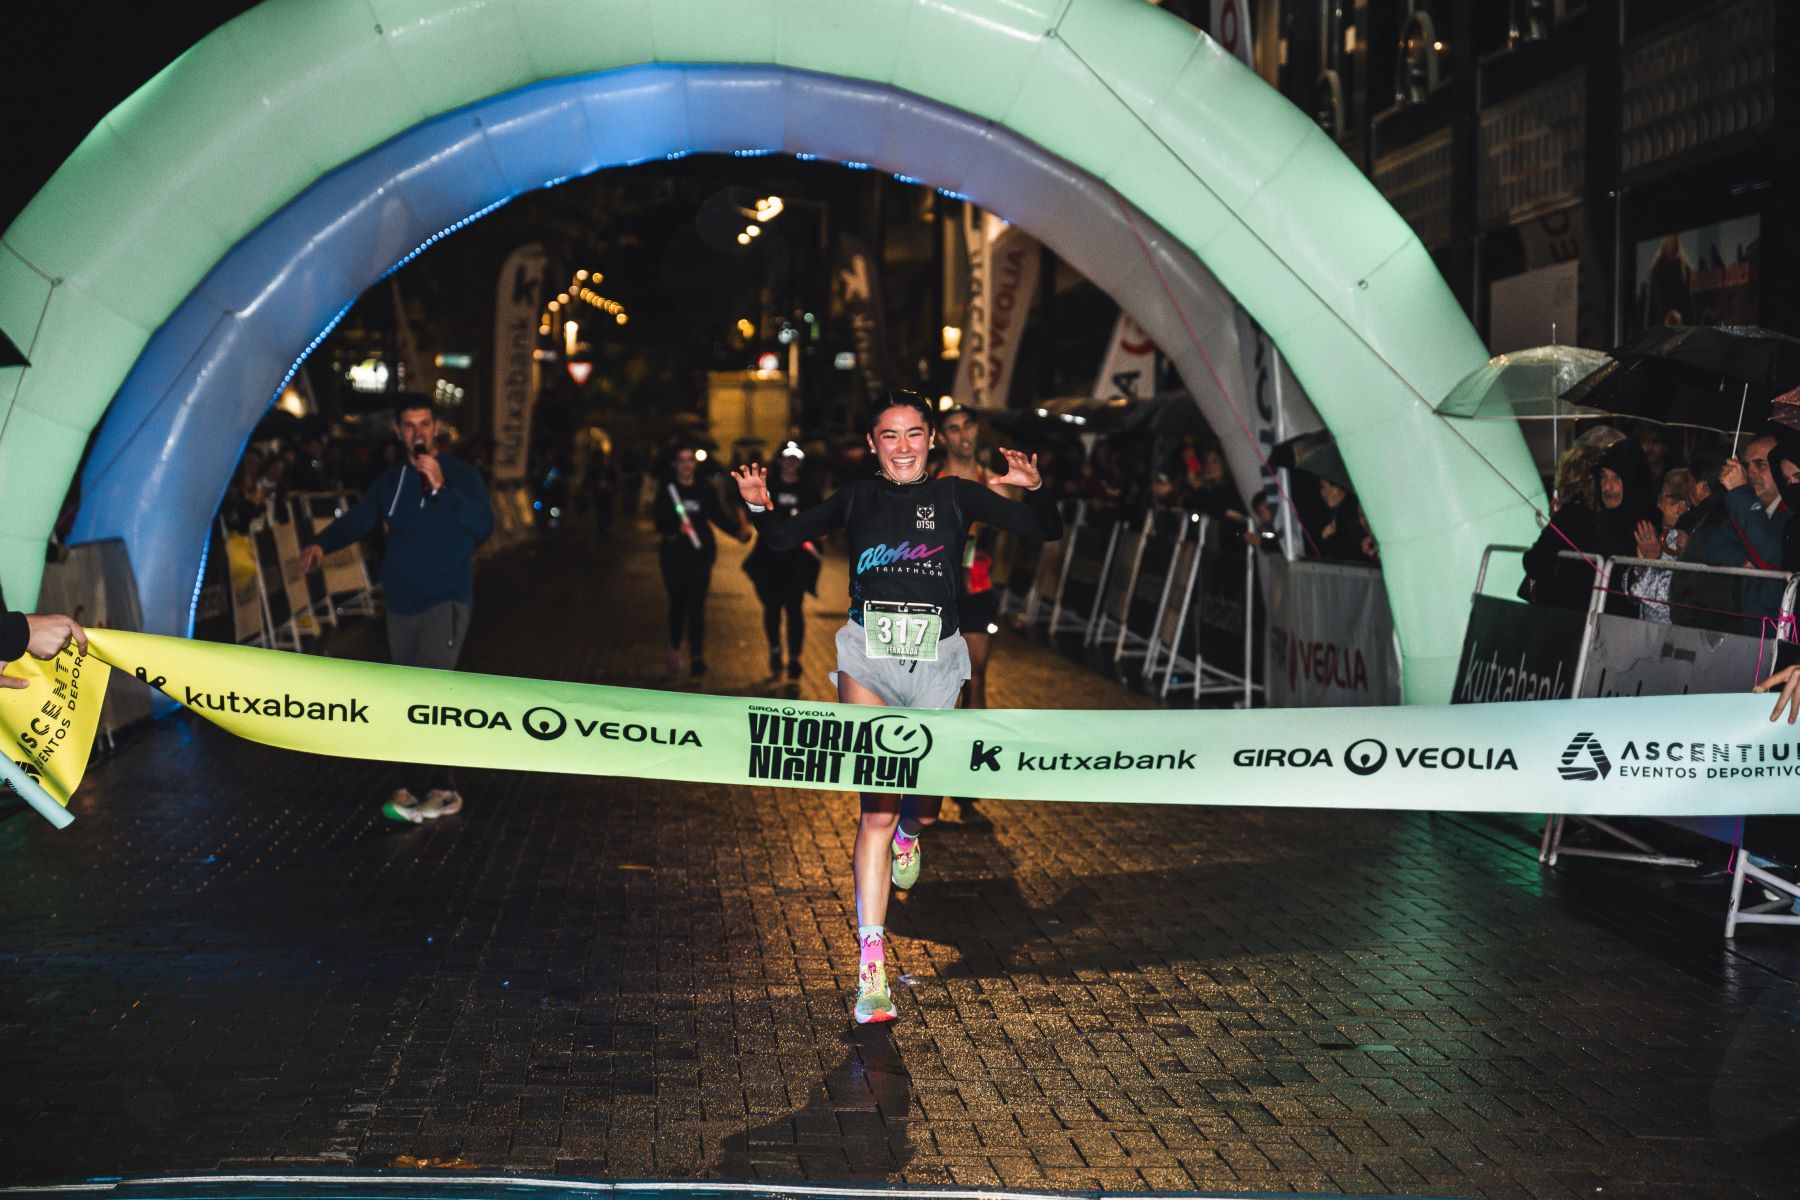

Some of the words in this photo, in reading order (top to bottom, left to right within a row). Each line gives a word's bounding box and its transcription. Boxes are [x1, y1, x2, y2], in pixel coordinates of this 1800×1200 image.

[916, 520, 935, 530] OTSO
[876, 566, 943, 577] TRIATHLON
[877, 616, 928, 646] 317
[886, 646, 918, 656] FERNANDA
[1299, 640, 1369, 692] VEOLIA
[1461, 640, 1566, 701] kutxabank
[185, 686, 370, 724] kutxabank
[748, 704, 780, 714] GIROA
[797, 710, 836, 718] VEOLIA
[407, 704, 512, 731] GIROA
[574, 718, 703, 747] VEOLIA
[748, 712, 873, 755] VITORIA
[1017, 749, 1198, 771] kutxabank
[1232, 748, 1334, 768] GIROA
[1394, 747, 1519, 771] VEOLIA
[1620, 740, 1800, 763] ASCENTIU
[748, 744, 846, 784] NIGHT
[852, 753, 920, 789] RUN
[1619, 765, 1697, 779] EVENTOS
